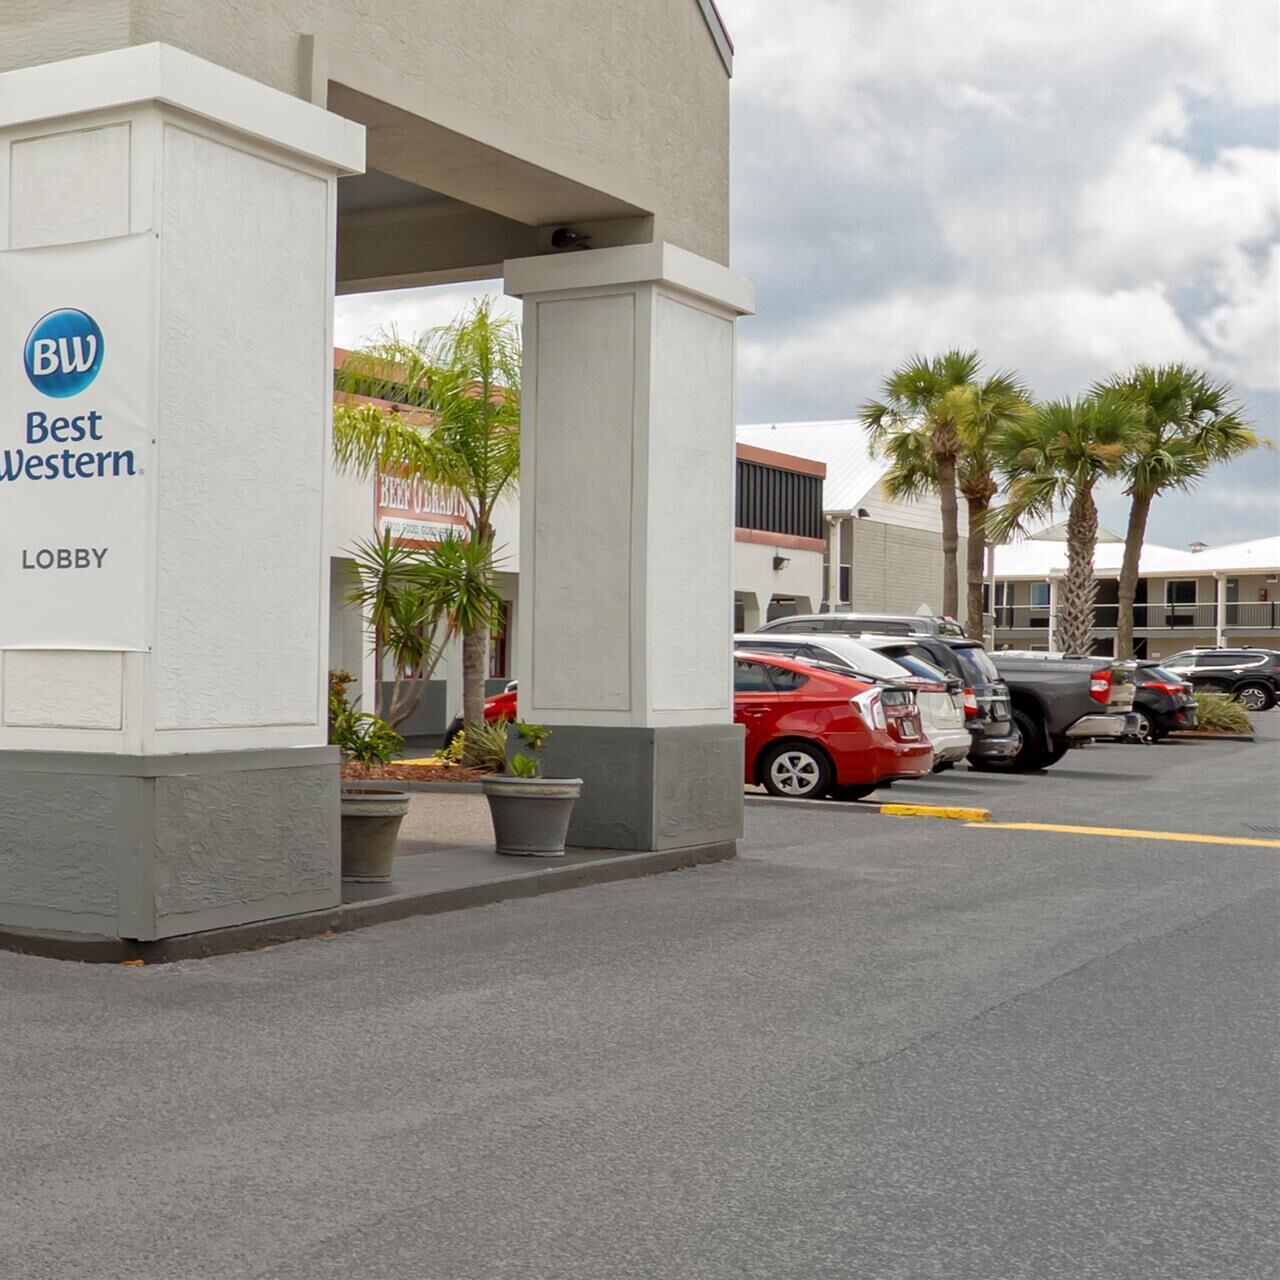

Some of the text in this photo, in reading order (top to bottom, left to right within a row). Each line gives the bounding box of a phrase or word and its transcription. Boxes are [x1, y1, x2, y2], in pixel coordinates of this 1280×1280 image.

[33, 334, 97, 376] BW
[26, 411, 103, 444] Best
[22, 548, 109, 569] LOBBY
